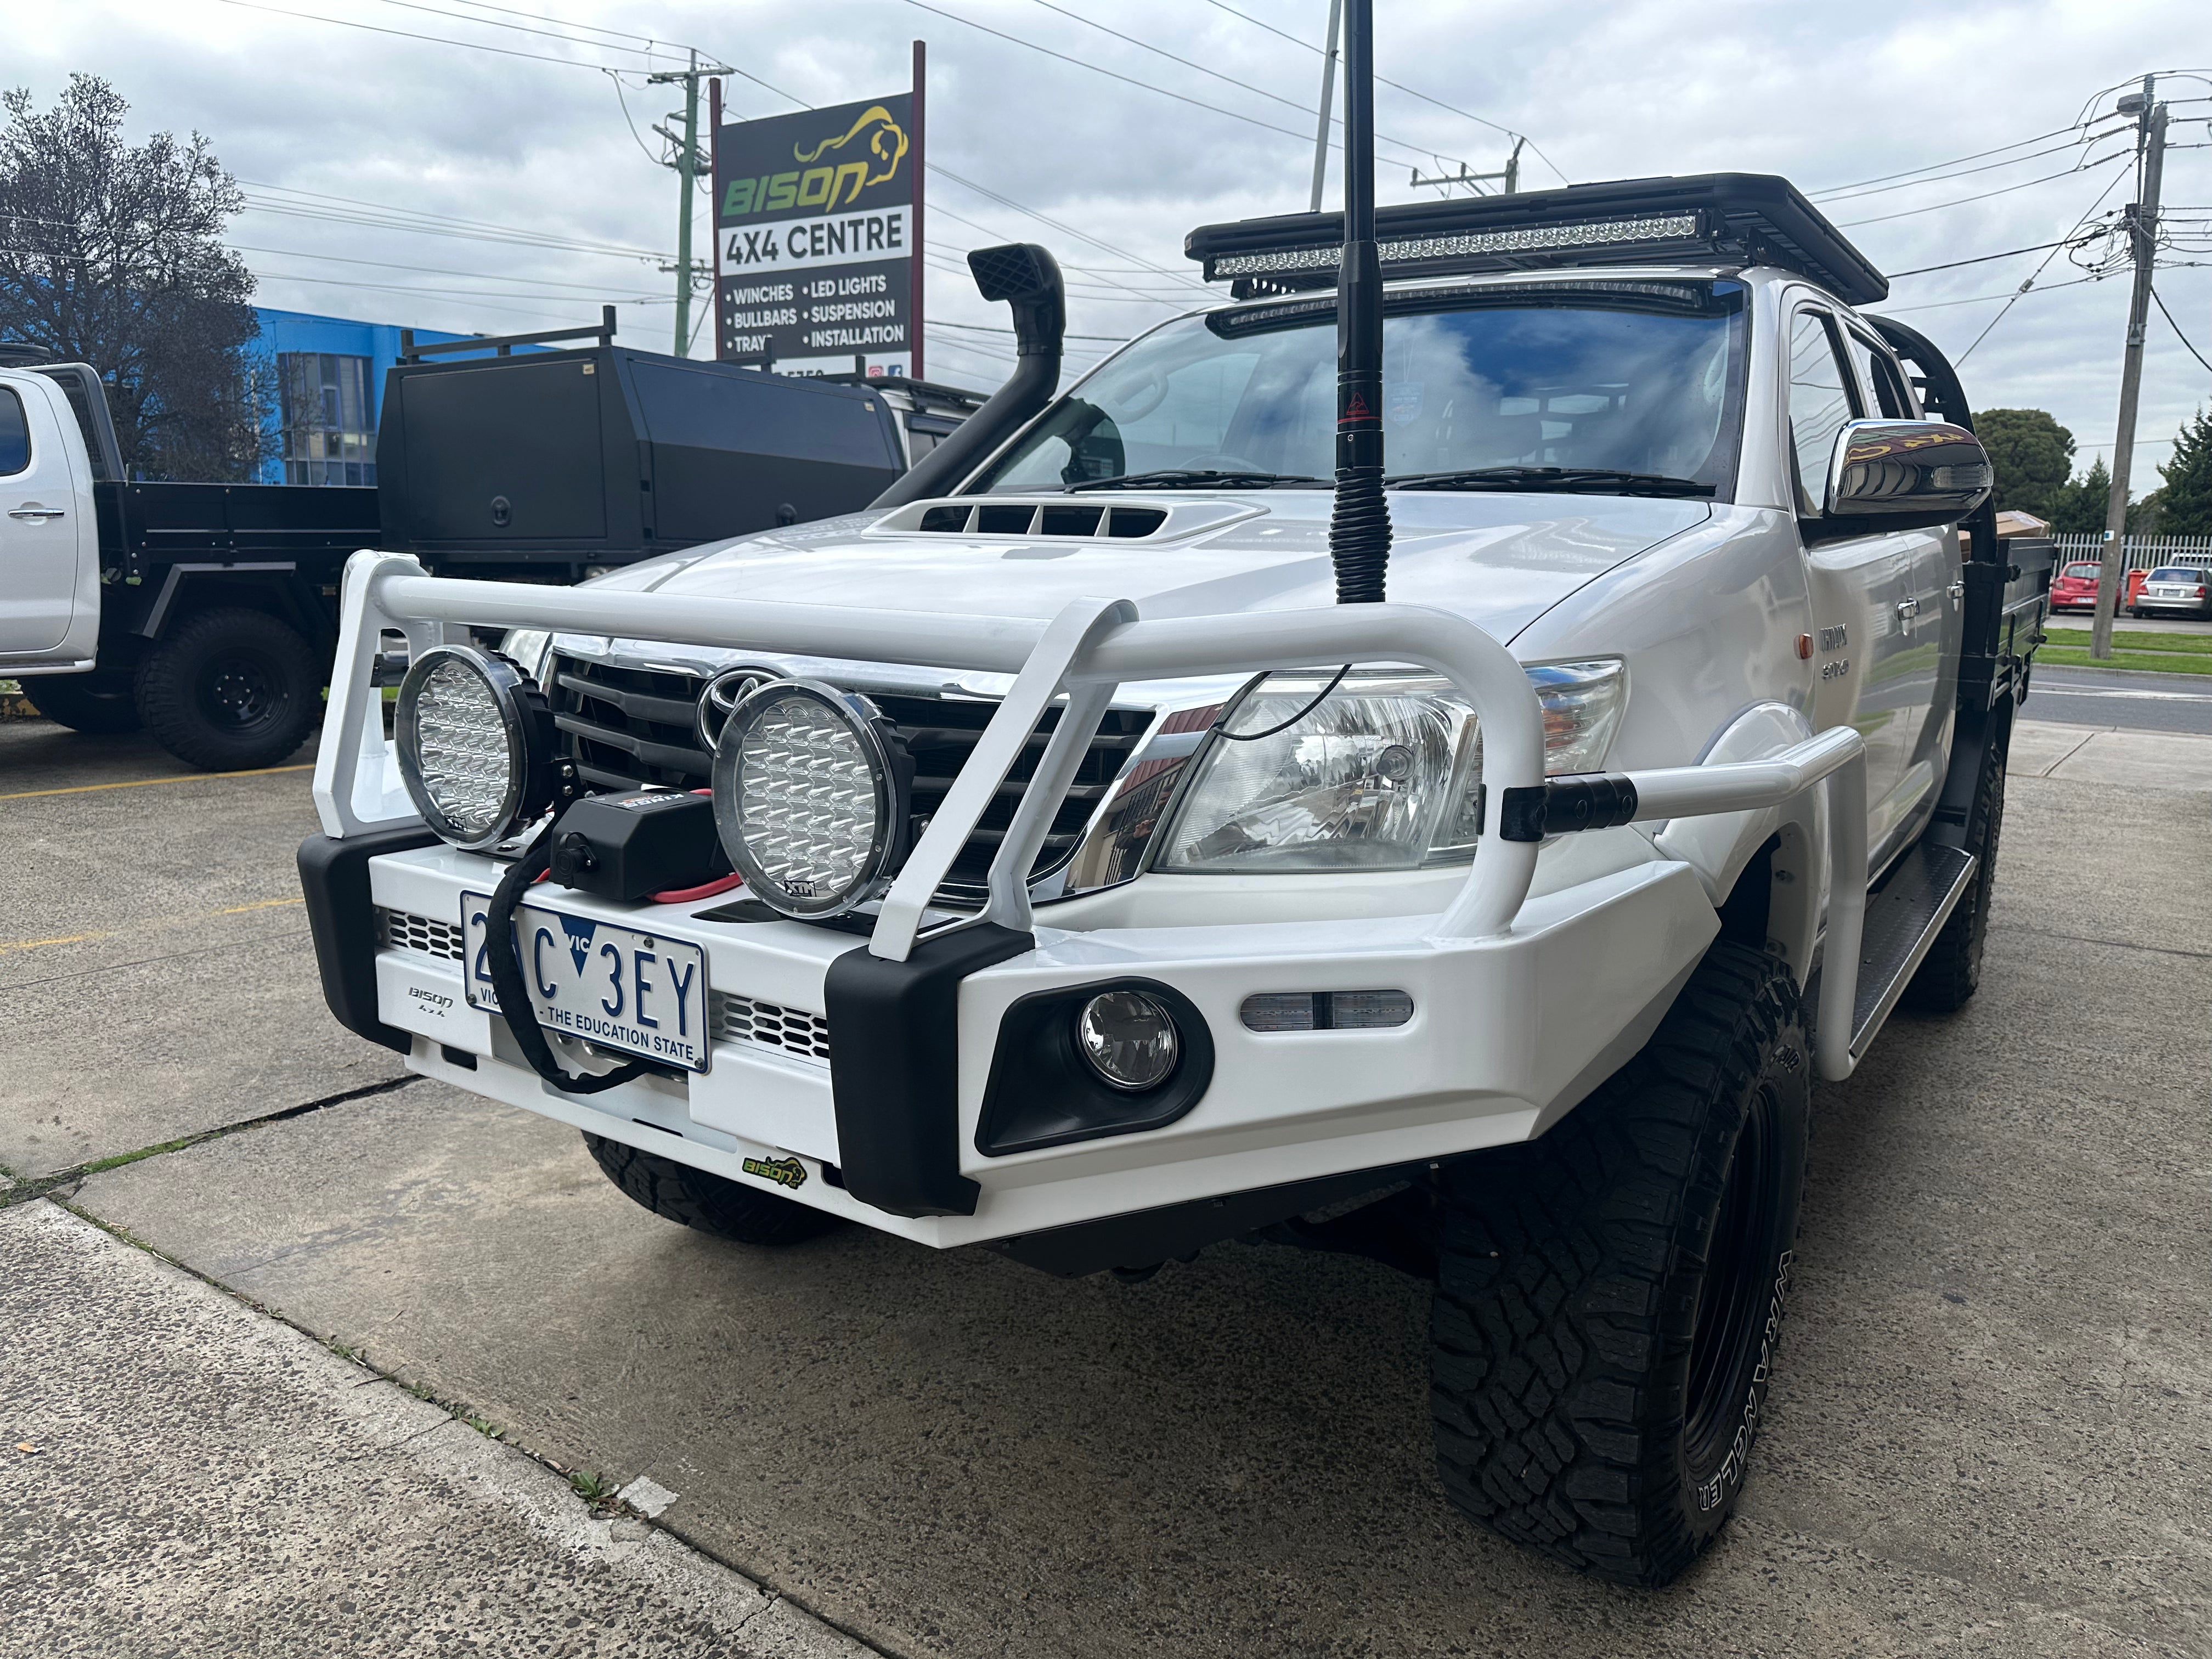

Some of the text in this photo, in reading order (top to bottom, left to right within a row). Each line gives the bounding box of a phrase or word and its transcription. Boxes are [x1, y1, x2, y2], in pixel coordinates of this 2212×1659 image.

[722, 161, 868, 216] BISON
[727, 213, 902, 265] 4X4 CENTRE
[734, 284, 794, 305] WINCHES
[811, 275, 887, 298] LED LIGHTS
[735, 308, 798, 329] BULLBARS
[811, 300, 895, 324] SUSPENSION
[735, 334, 773, 353] TRAY
[811, 325, 905, 348] INSTALLATION
[785, 881, 816, 897] XTM
[565, 933, 590, 953] VIC
[408, 987, 453, 1008] BISON
[548, 1006, 694, 1060] THE EDUCATION STATE
[743, 1159, 793, 1183] BISON
[1699, 1249, 1792, 1511] WRANGLER
